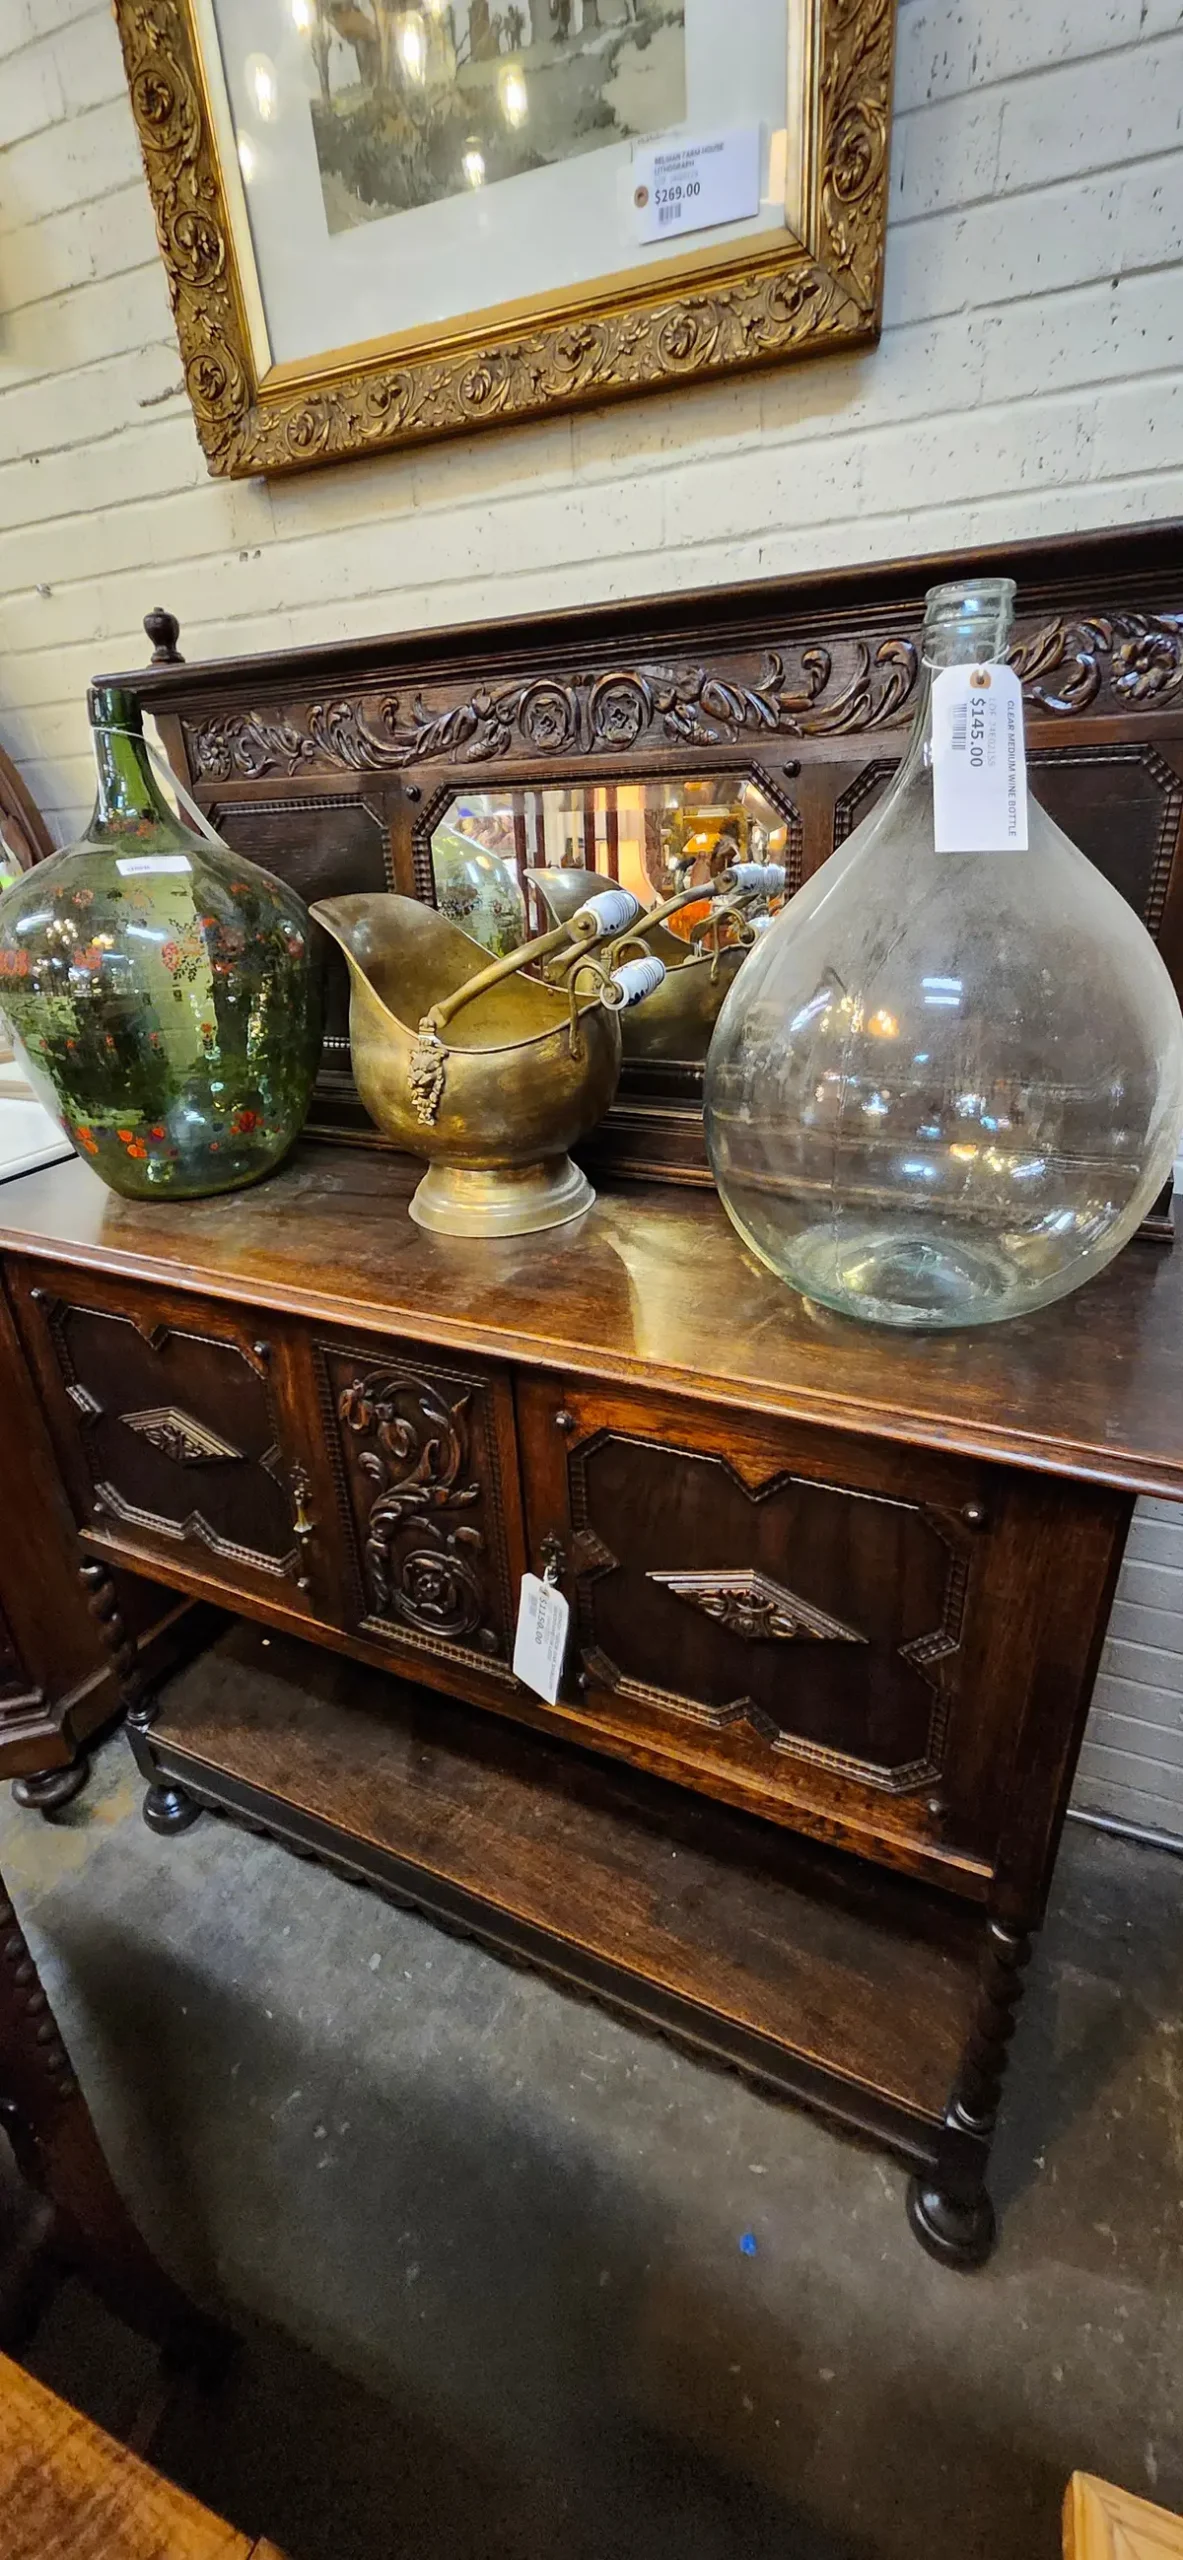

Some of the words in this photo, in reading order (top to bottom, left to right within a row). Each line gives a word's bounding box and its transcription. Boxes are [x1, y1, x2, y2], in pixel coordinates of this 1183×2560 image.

[655, 181, 701, 205] $269.00
[970, 697, 986, 768] $145.00
[1007, 700, 1015, 731] CLEAR
[1008, 732, 1016, 772] MEDIUM
[1008, 774, 1016, 798] WINE
[1008, 800, 1017, 836] BOTTLE
[534, 1596, 548, 1645] $1150.00
